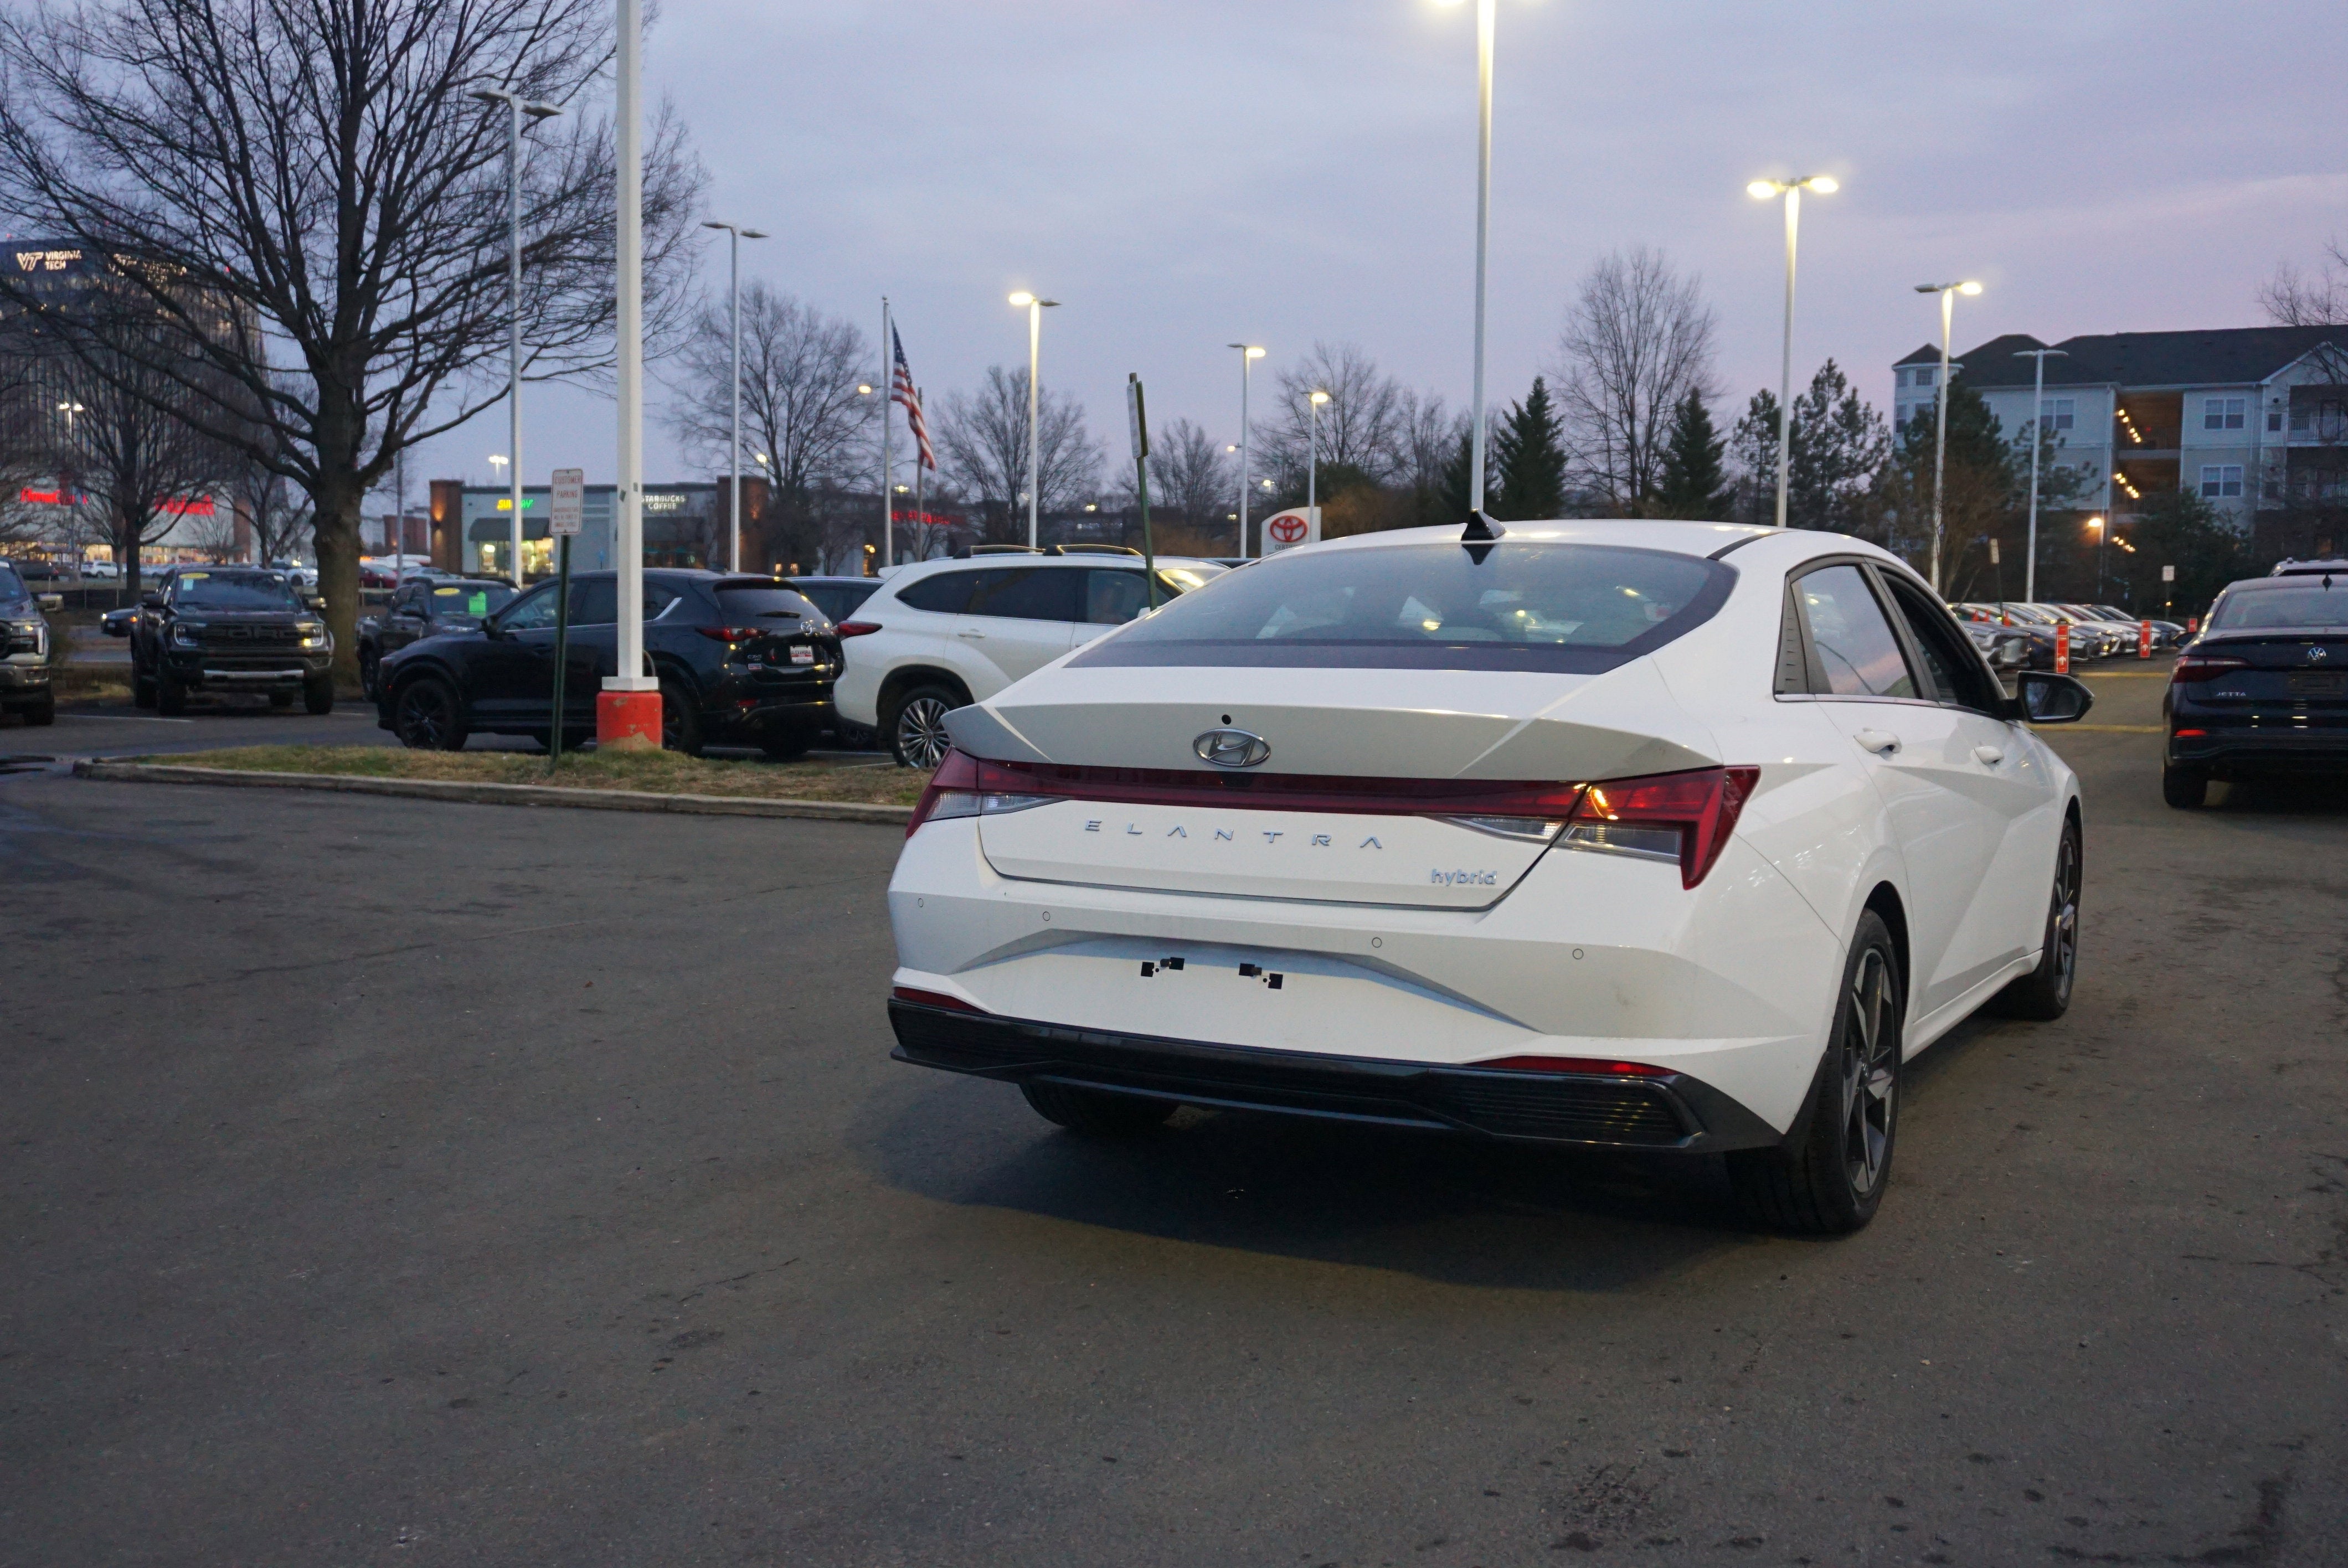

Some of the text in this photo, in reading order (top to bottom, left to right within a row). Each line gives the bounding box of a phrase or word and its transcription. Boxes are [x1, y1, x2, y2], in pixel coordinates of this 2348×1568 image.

[45, 250, 81, 260] VIRGINIA
[45, 260, 66, 270] TECH
[557, 490, 577, 498] PARKING
[497, 499, 534, 509] SUAY
[1085, 819, 1382, 849] ELANTRA
[1432, 868, 1497, 886] hybrid
